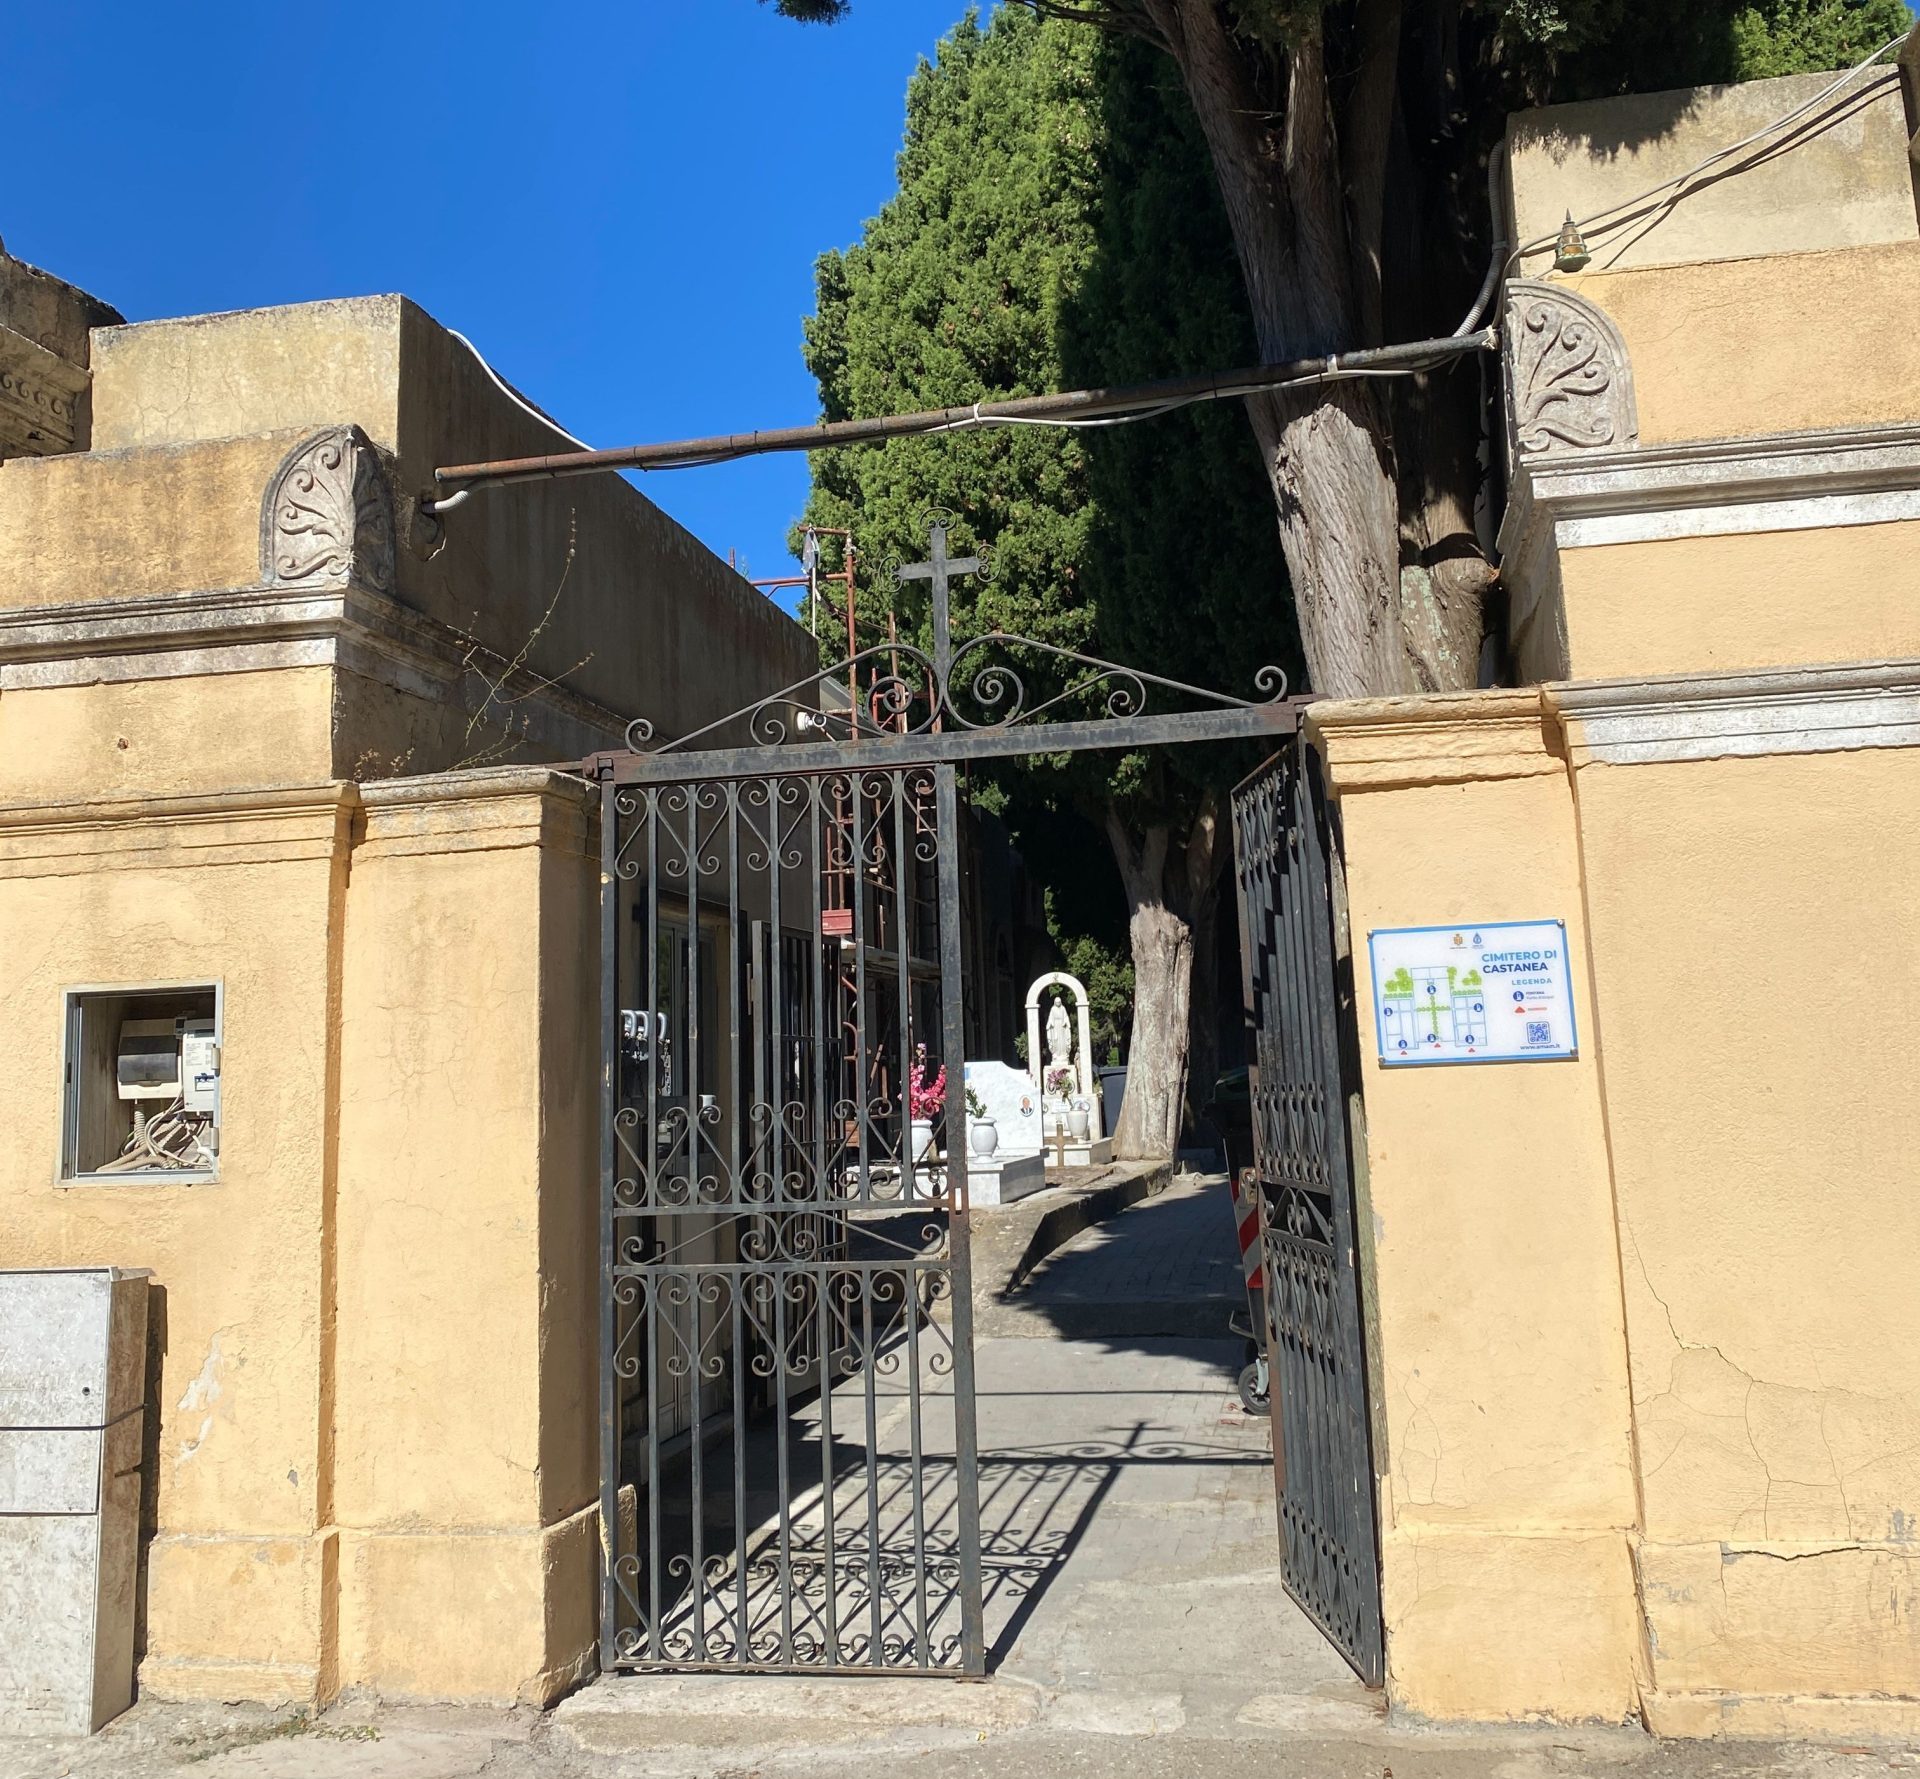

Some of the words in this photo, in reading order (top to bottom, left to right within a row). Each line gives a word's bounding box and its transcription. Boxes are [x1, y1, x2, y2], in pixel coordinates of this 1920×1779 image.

[1481, 951, 1541, 962] CIMITERO
[1544, 950, 1557, 959] DI
[1482, 962, 1549, 974] CASTANEA
[1511, 978, 1553, 986] LEGENDA
